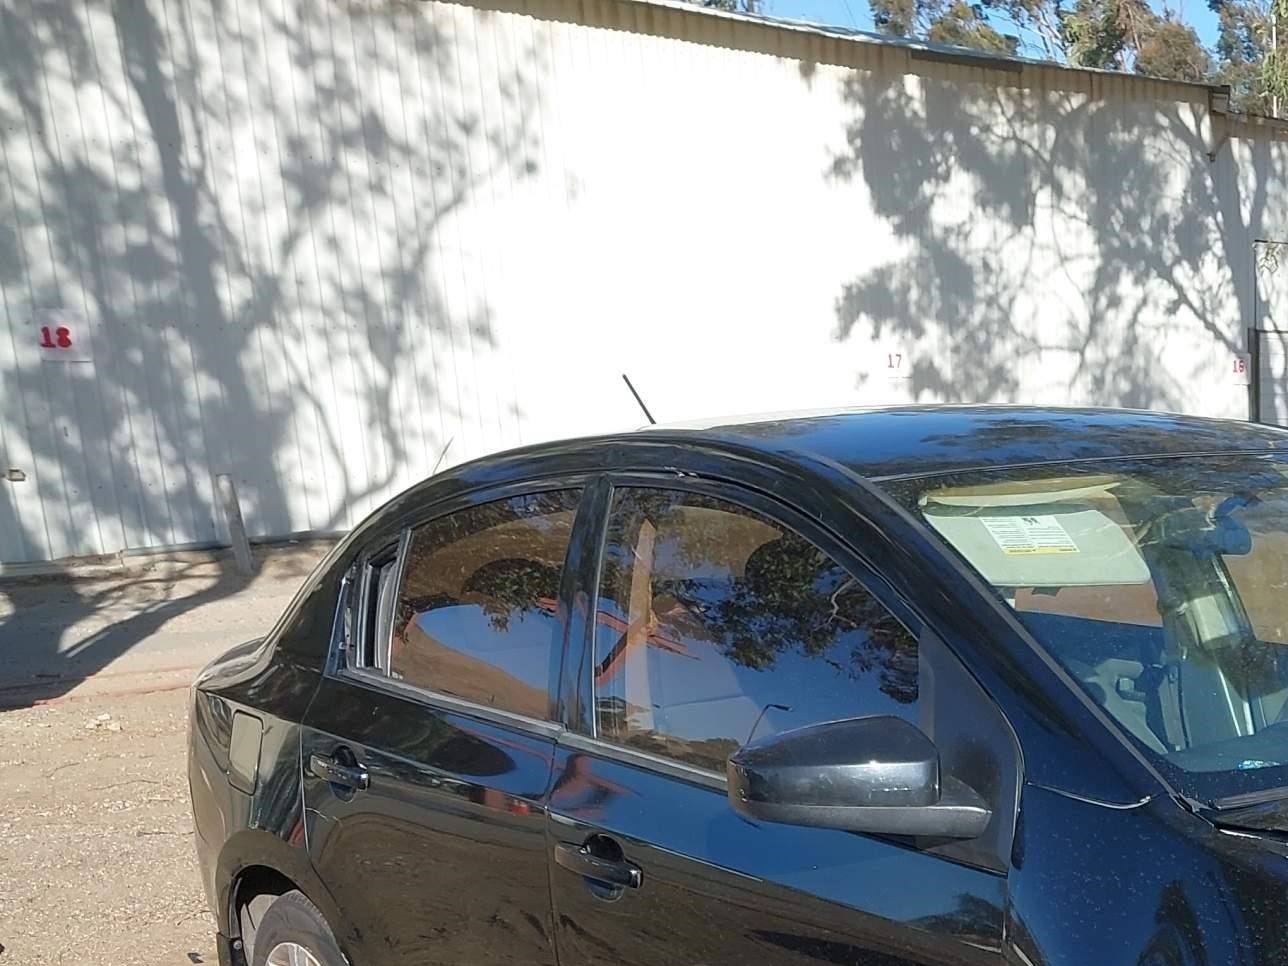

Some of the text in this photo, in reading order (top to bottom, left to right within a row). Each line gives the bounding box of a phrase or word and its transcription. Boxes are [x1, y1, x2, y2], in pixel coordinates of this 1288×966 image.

[40, 326, 72, 348] 18
[888, 353, 902, 368] 17
[1232, 359, 1244, 373] 16
